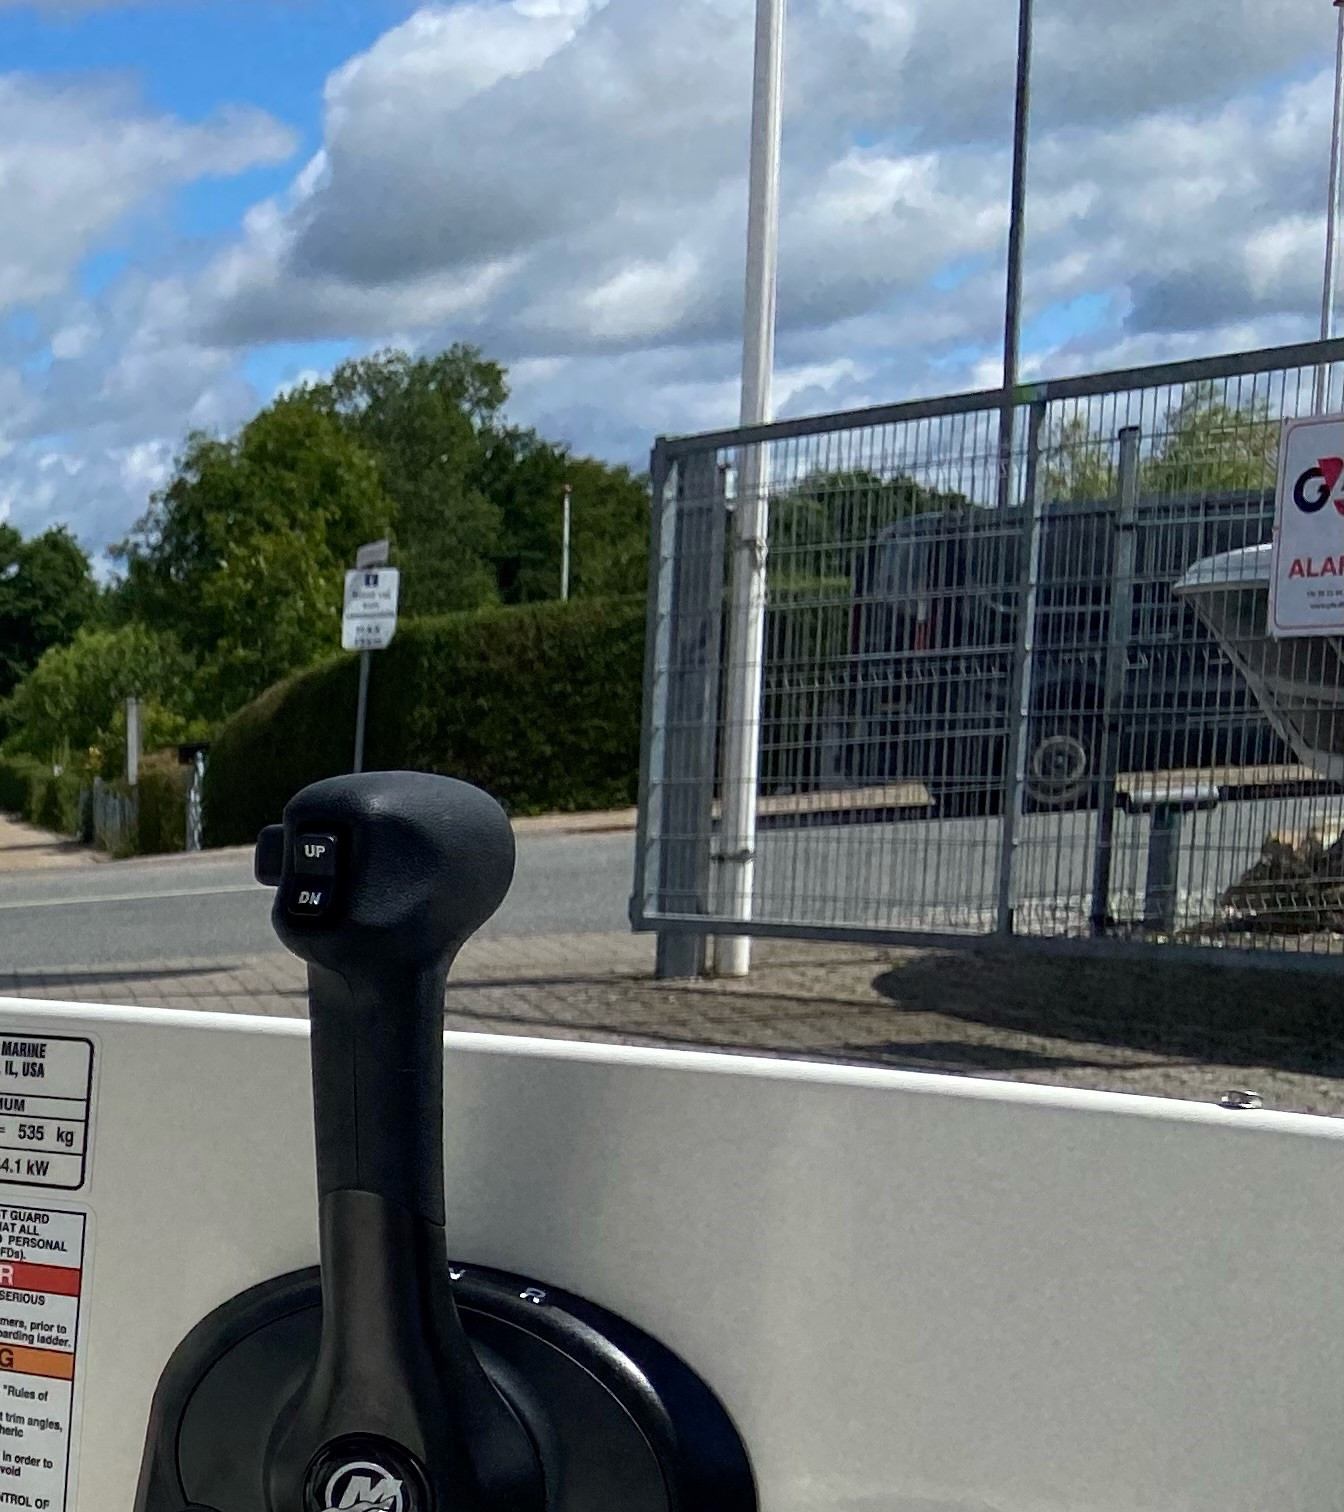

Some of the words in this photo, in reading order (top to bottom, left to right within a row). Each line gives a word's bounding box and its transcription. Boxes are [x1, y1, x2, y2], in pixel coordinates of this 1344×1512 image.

[304, 845, 326, 858] UP
[298, 891, 322, 905] DN
[0, 1040, 47, 1059] MARINE
[21, 1061, 45, 1078] USA
[17, 1123, 44, 1141] 535
[56, 1126, 74, 1147] kg
[26, 1159, 50, 1177] kW
[9, 1210, 50, 1224] GUARD
[18, 1223, 40, 1236] ALL
[7, 1234, 68, 1252] PERSONAL
[34, 1498, 50, 1510] OF
